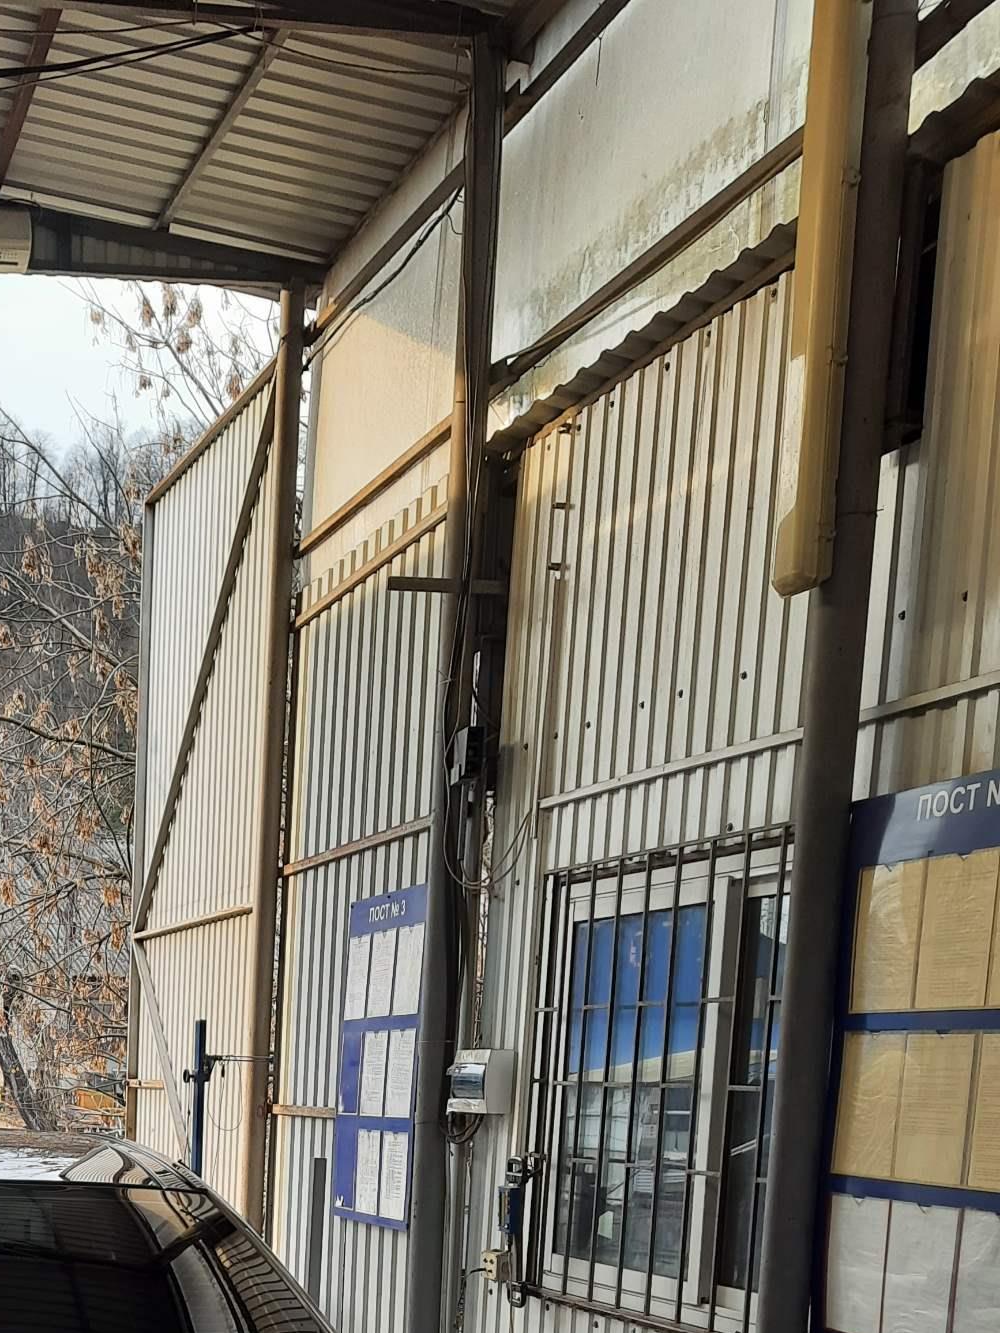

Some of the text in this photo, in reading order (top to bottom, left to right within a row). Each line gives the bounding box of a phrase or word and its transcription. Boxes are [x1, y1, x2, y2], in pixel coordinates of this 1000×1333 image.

[917, 782, 981, 821] ПОСТ
[369, 900, 406, 922] ПОСТ № 3
